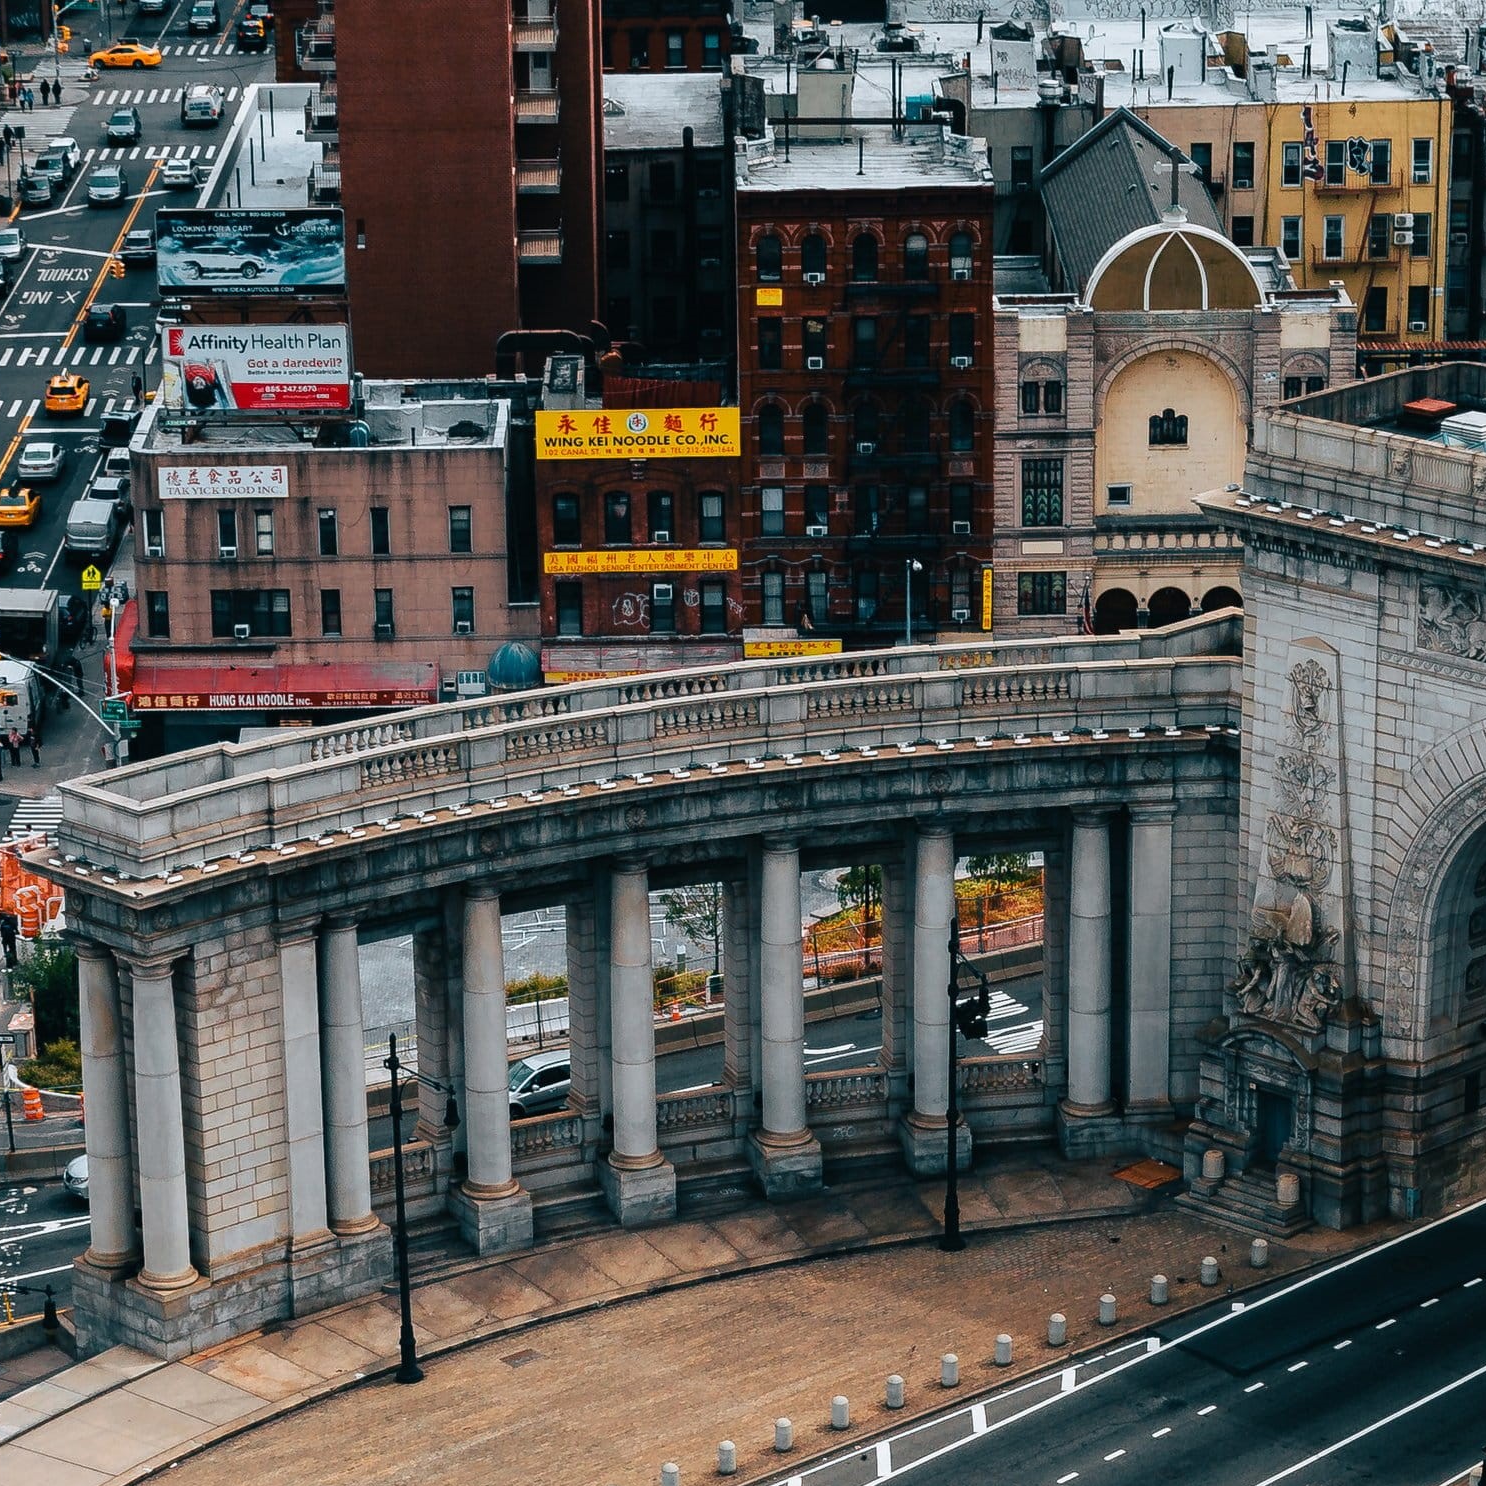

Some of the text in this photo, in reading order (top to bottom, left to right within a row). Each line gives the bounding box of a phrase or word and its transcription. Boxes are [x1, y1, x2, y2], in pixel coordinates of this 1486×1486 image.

[37, 268, 93, 282] SCHOOL
[188, 333, 341, 353] Affinity Health Plan
[247, 358, 343, 369] Got a daredevil?
[557, 415, 613, 435] 永佳
[544, 437, 584, 447] WING
[588, 436, 609, 447] KEI
[613, 435, 670, 446] NOODLE
[561, 448, 588, 456] CANAL
[686, 446, 735, 454] 212-226-1644
[166, 468, 283, 486] 德益食品公司
[166, 486, 283, 495] TAK YICK FOOD INC.
[633, 563, 701, 571] ENTERTAINMENT
[702, 562, 735, 570] CENTER
[209, 693, 314, 707] HUNG KAI NOODLE INC.
